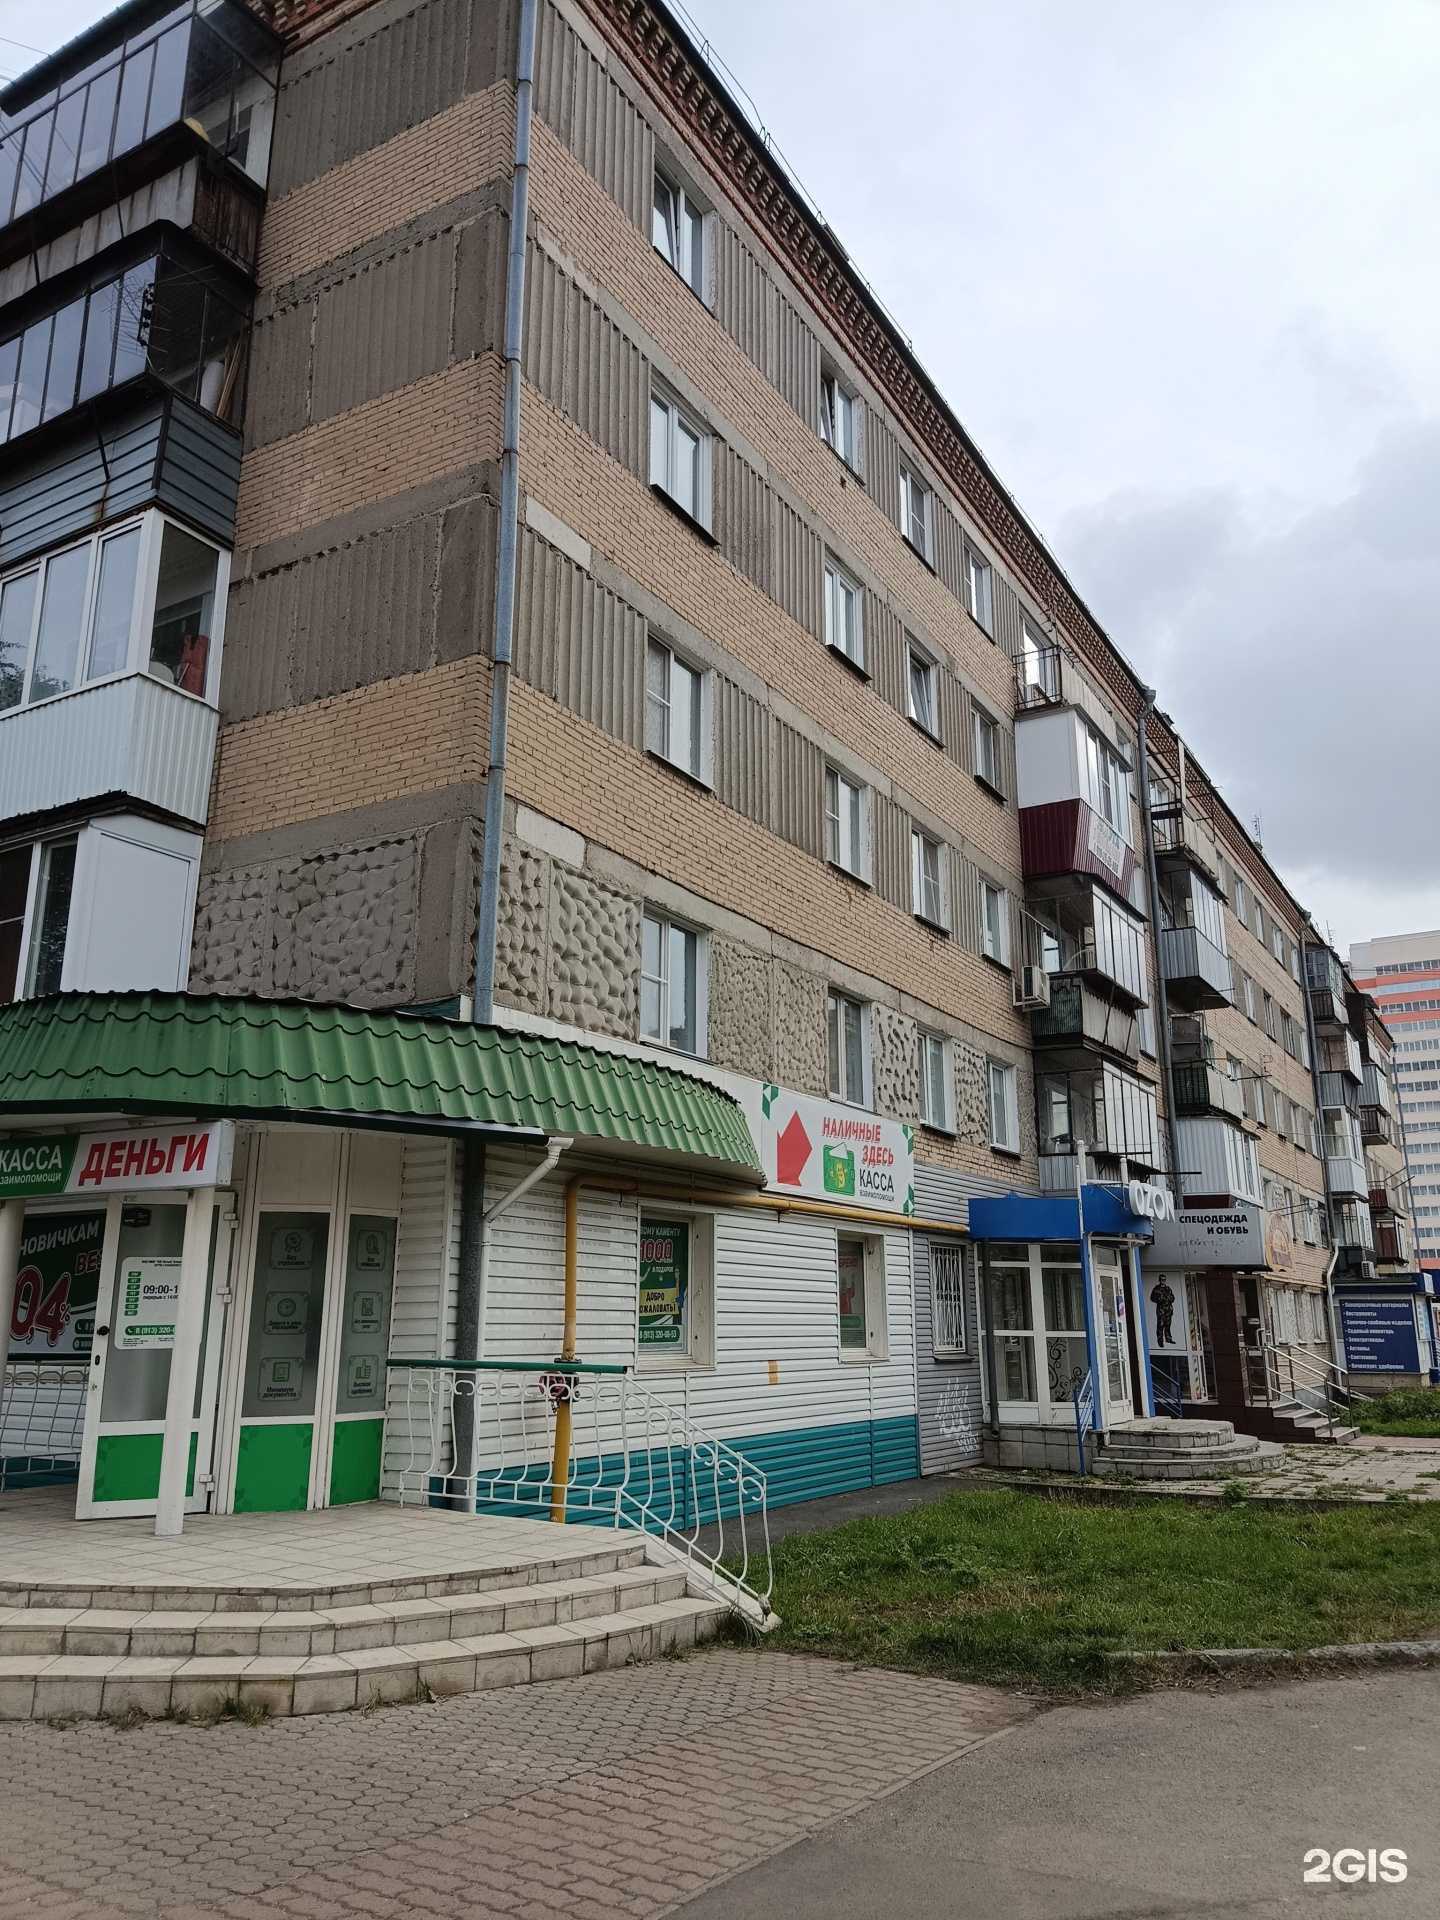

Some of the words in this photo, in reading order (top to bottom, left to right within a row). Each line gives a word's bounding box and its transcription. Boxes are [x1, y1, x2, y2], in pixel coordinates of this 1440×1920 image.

[822, 1116, 881, 1142] НАЛИЧНЫЕ
[0, 1144, 62, 1173] КАССА
[78, 1133, 210, 1187] ДЕНЬГИ
[862, 1145, 894, 1168] ЗДЕСЬ
[0, 1172, 62, 1185] заимопомощи
[859, 1168, 894, 1193] КАССА
[1129, 1180, 1176, 1223] OZON
[1179, 1214, 1248, 1225] СПЕЦОДЕЖДА
[1207, 1227, 1215, 1235] И
[1217, 1226, 1249, 1235] ОБУВЬ
[143, 1285, 178, 1294] 09:00-1
[640, 1303, 676, 1314] ОЖАЛОВАТЬ!
